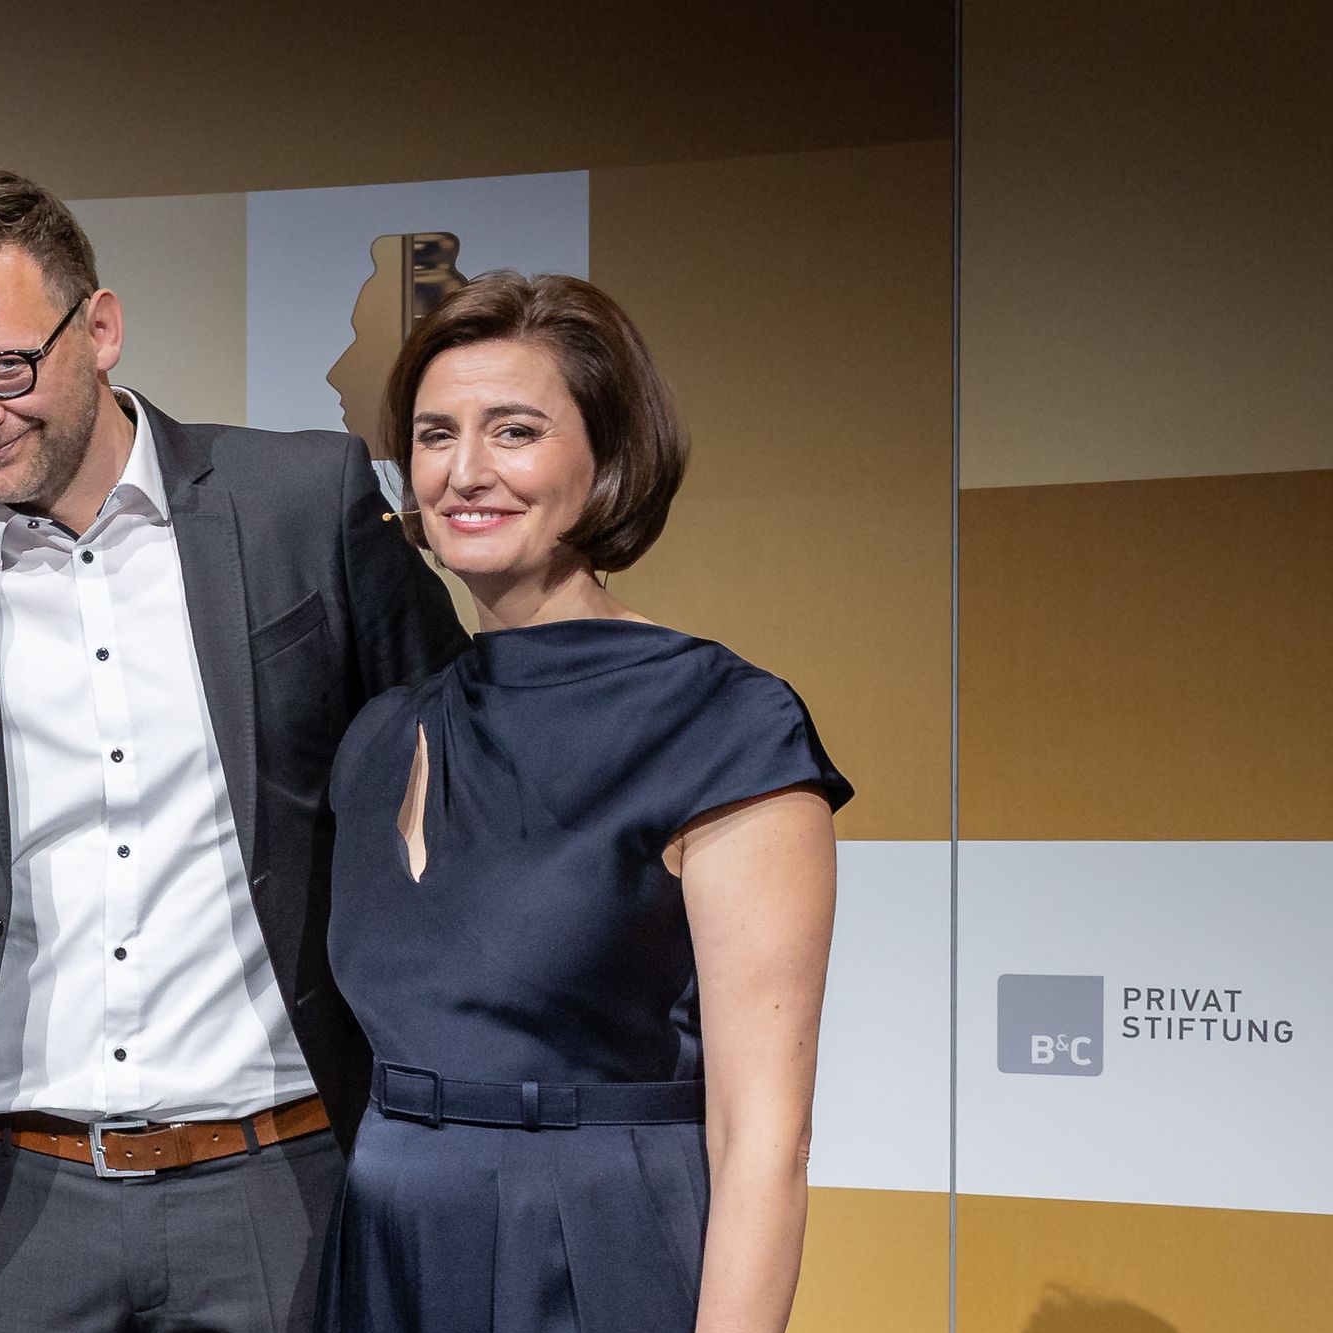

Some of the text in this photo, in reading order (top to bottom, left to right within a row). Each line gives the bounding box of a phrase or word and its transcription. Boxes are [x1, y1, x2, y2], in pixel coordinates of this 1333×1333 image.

[1123, 987, 1242, 1013] PRIVAT
[1121, 1016, 1293, 1044] STIFTUNG
[1031, 1034, 1092, 1066] B&C
